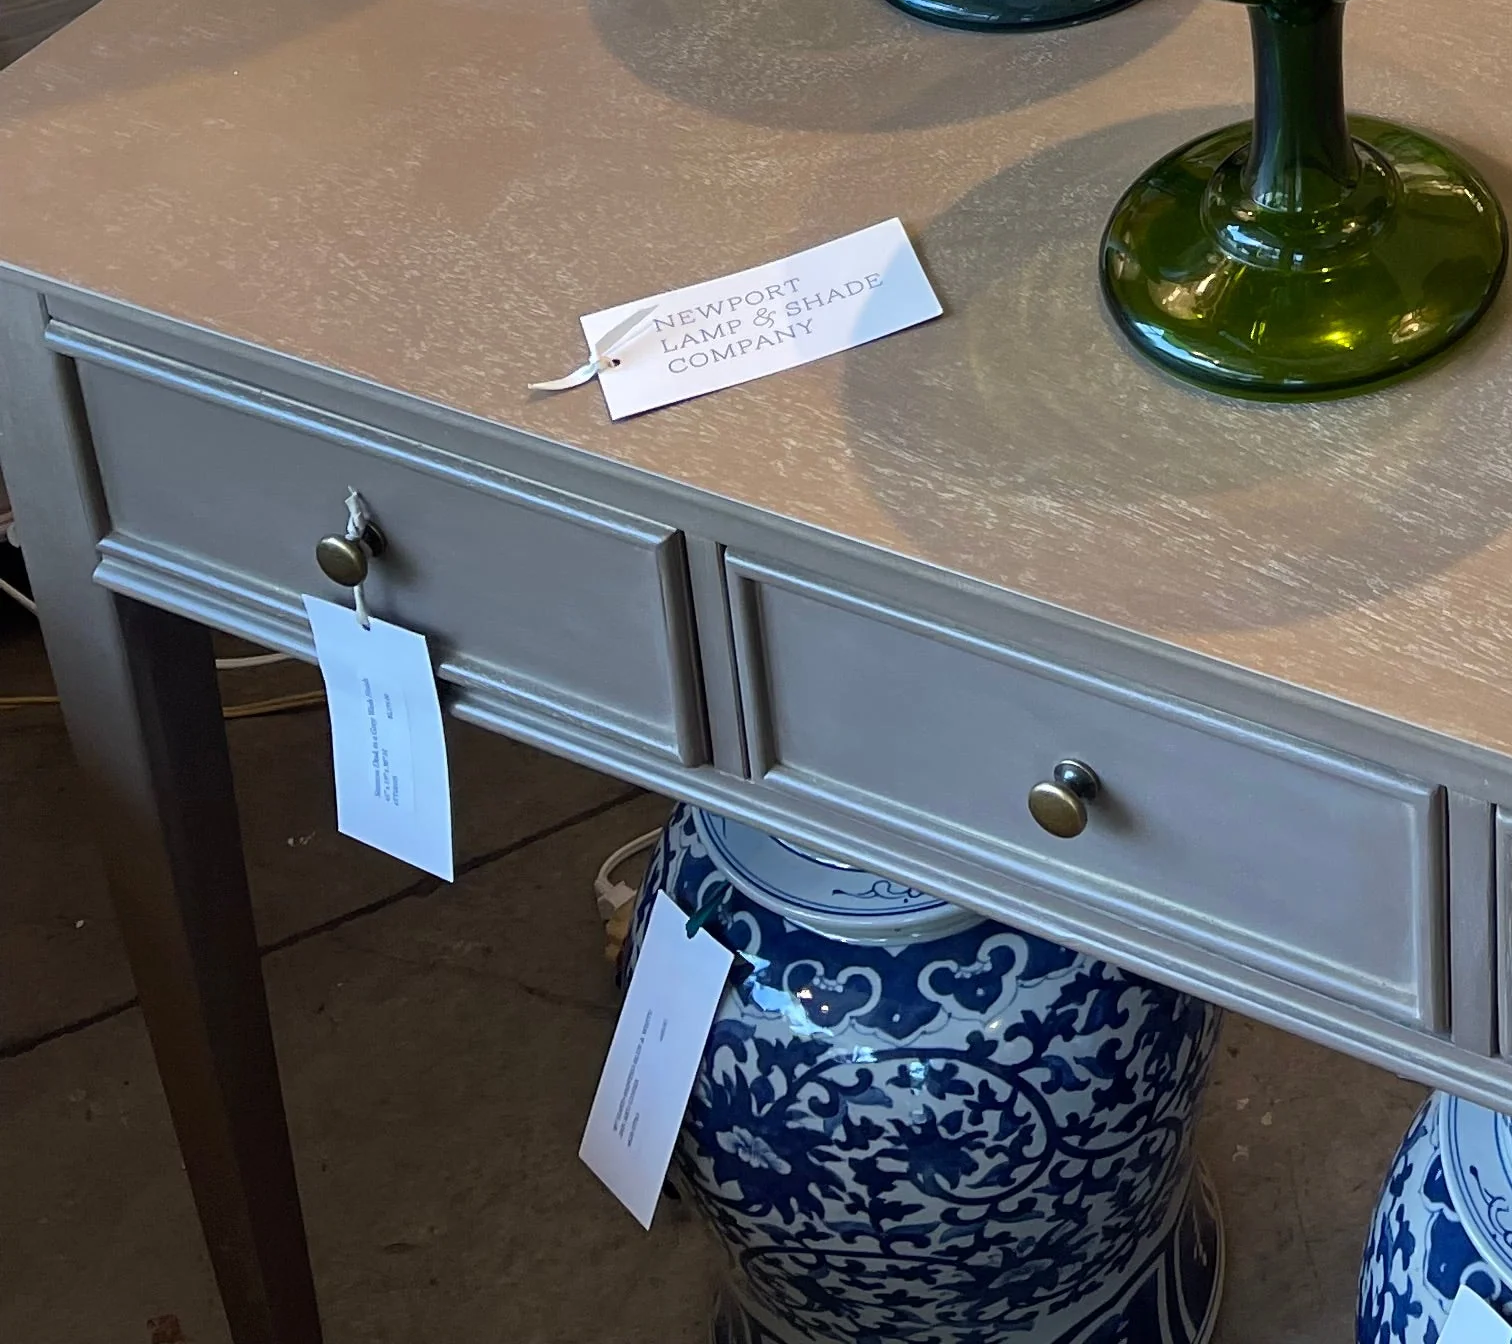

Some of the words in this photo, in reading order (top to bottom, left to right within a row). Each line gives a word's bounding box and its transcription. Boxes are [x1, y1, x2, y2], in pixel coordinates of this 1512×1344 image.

[652, 277, 801, 333] NEWPORT
[660, 319, 742, 354] LAMP
[752, 307, 776, 329] &
[785, 272, 884, 318] SHADE
[668, 317, 814, 374] COMPANY
